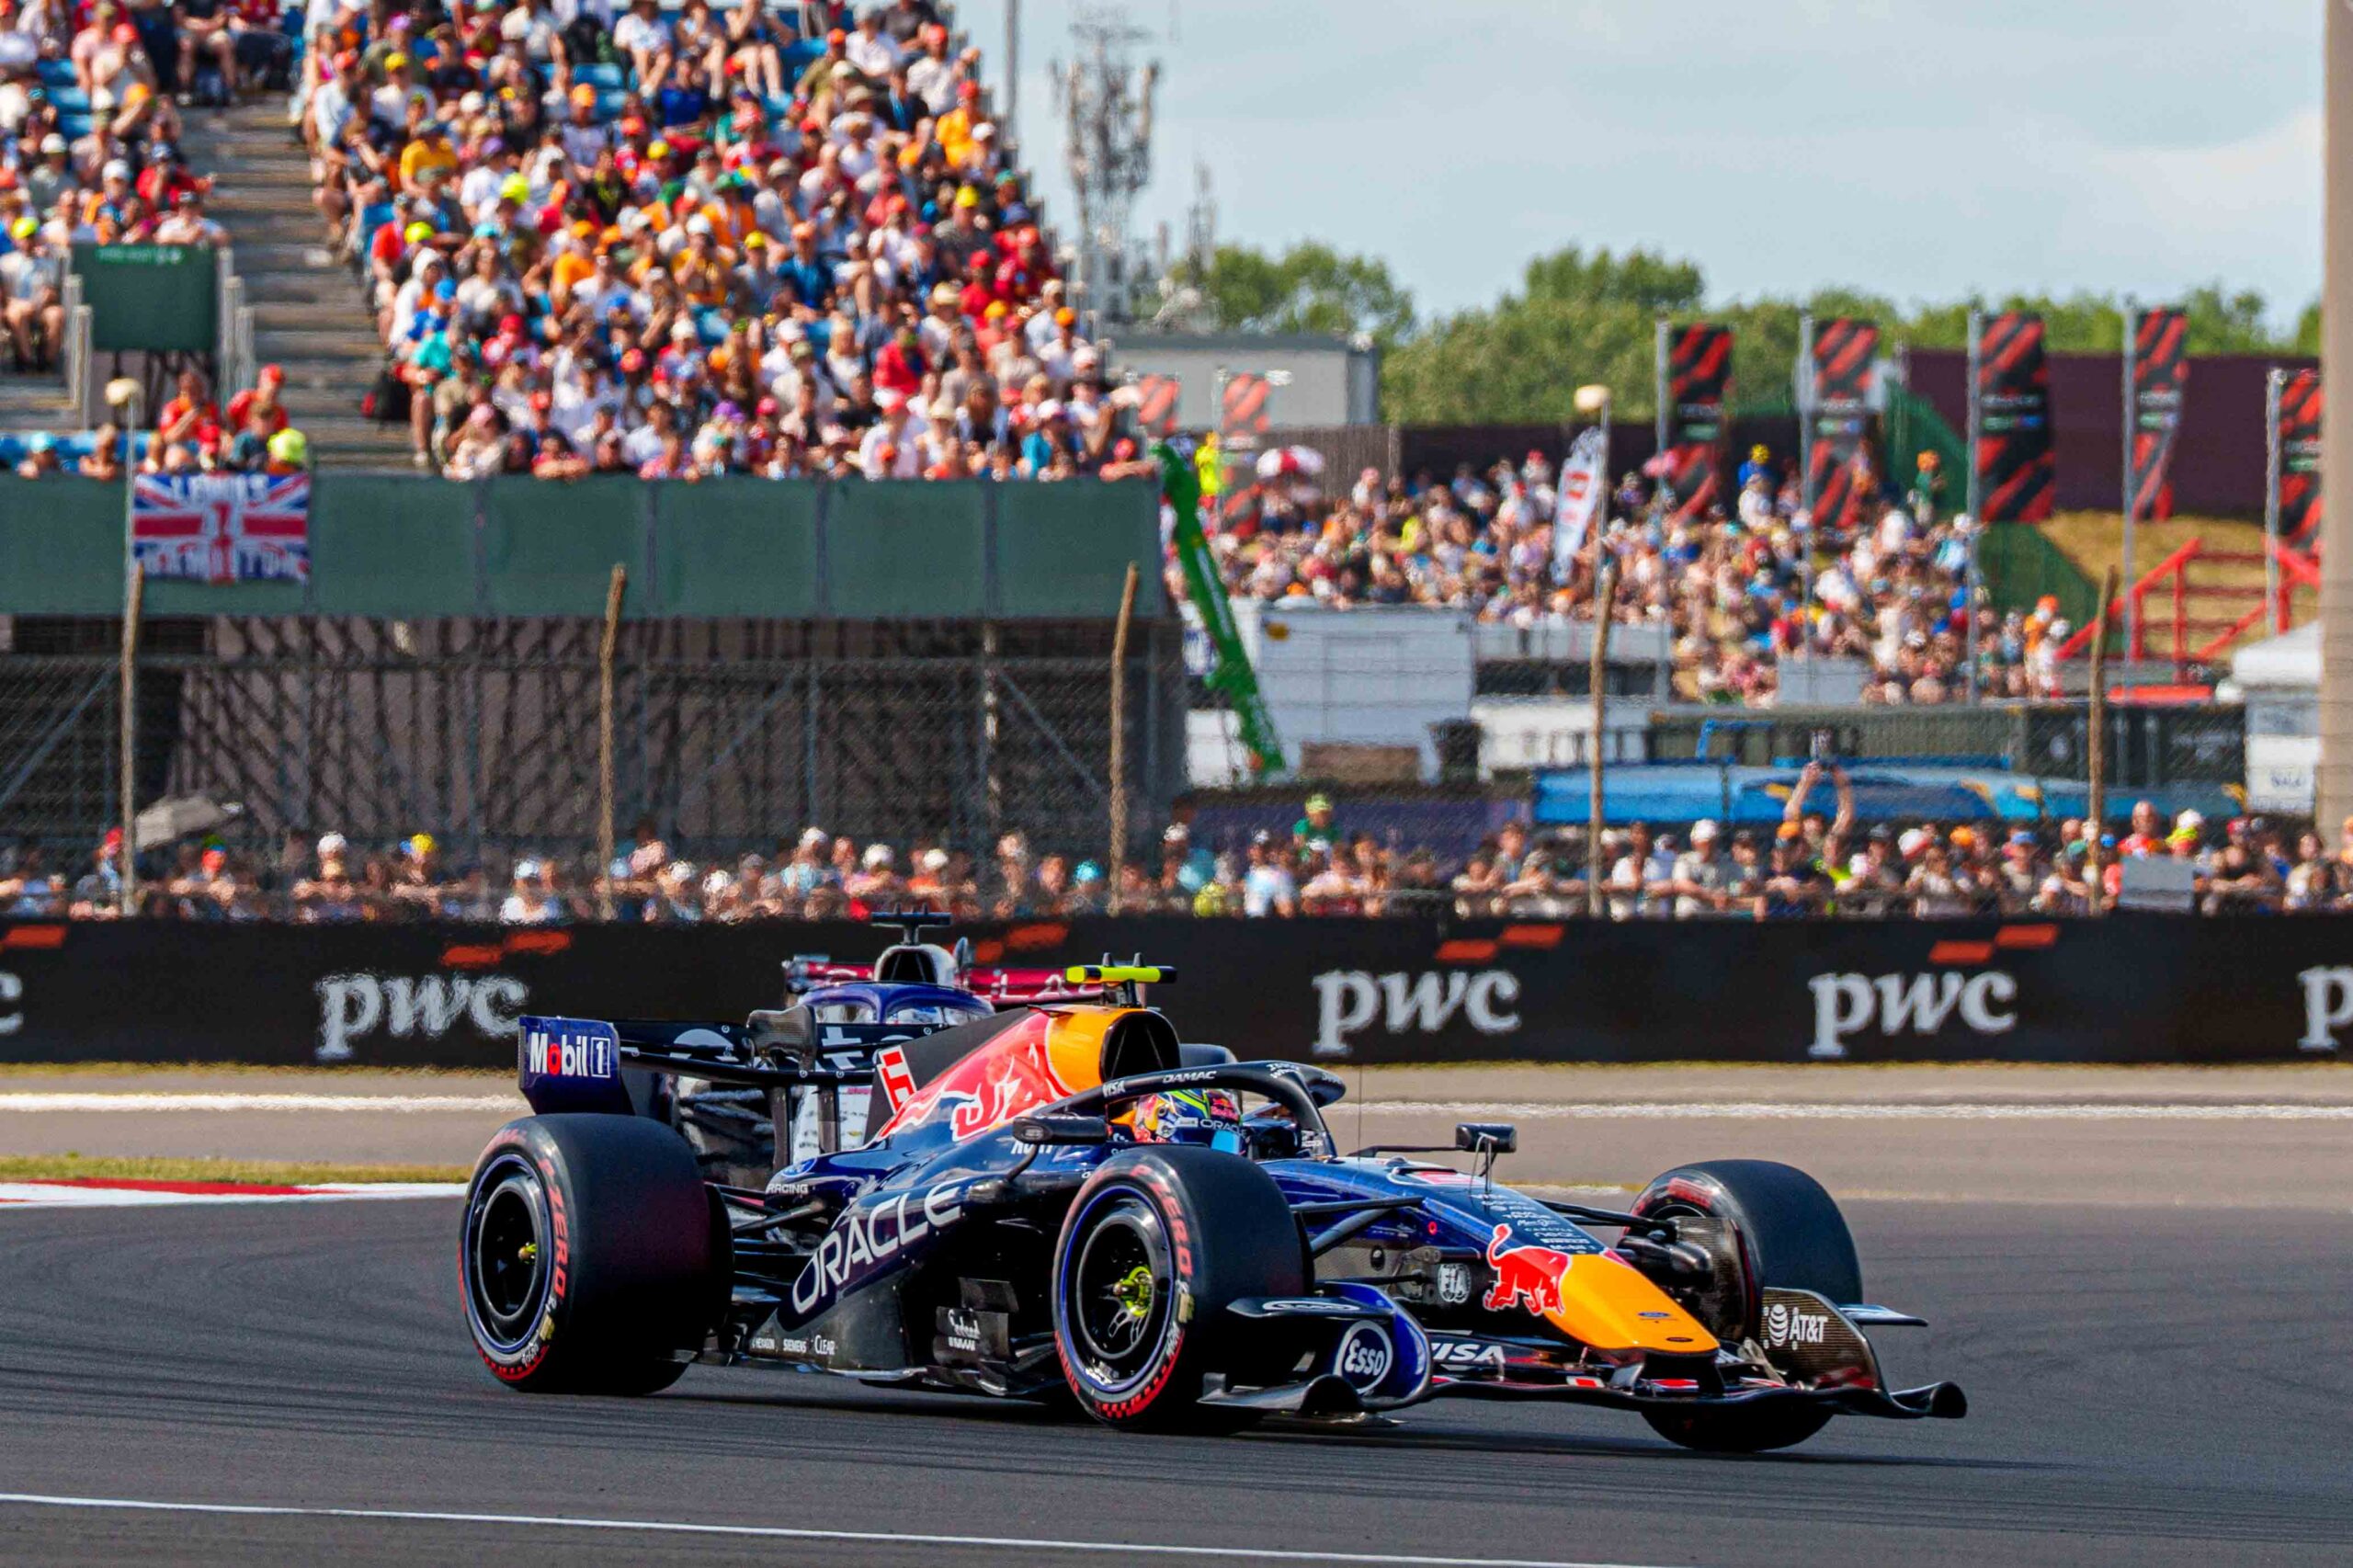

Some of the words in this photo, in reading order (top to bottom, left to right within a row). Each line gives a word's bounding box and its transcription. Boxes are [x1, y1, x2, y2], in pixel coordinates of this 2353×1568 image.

[314, 973, 529, 1059] pwc
[1312, 970, 1522, 1053] pwc
[1807, 971, 2018, 1056] pwc
[529, 1031, 588, 1076] Mobil
[1162, 1070, 1218, 1085] DAMAC
[1102, 1080, 1126, 1097] VISA
[765, 1183, 809, 1195] RACING
[791, 1176, 962, 1314] ORACLE
[1148, 1181, 1193, 1278] ZERO
[1789, 1312, 1829, 1343] AT&T
